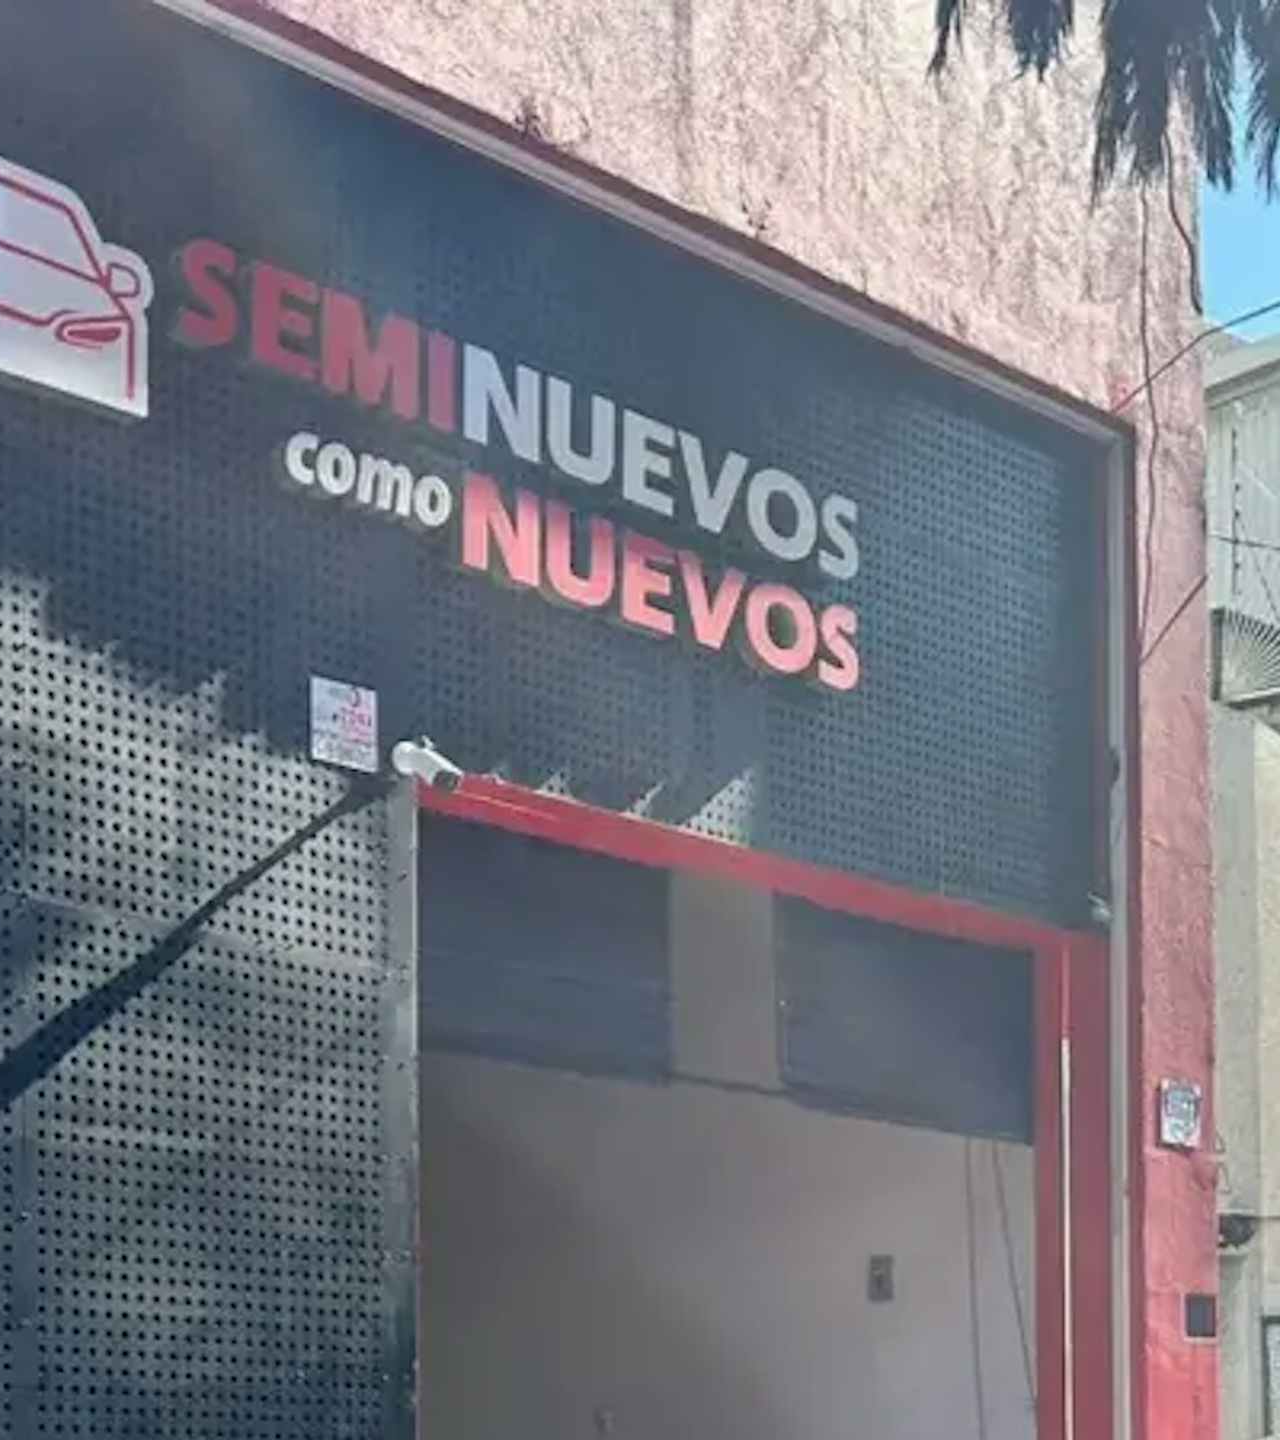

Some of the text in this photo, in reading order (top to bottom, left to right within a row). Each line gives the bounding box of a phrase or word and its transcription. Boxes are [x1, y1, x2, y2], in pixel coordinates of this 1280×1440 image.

[175, 237, 859, 580] SEMINUEVOS
[285, 431, 860, 692] como NUEVOS
